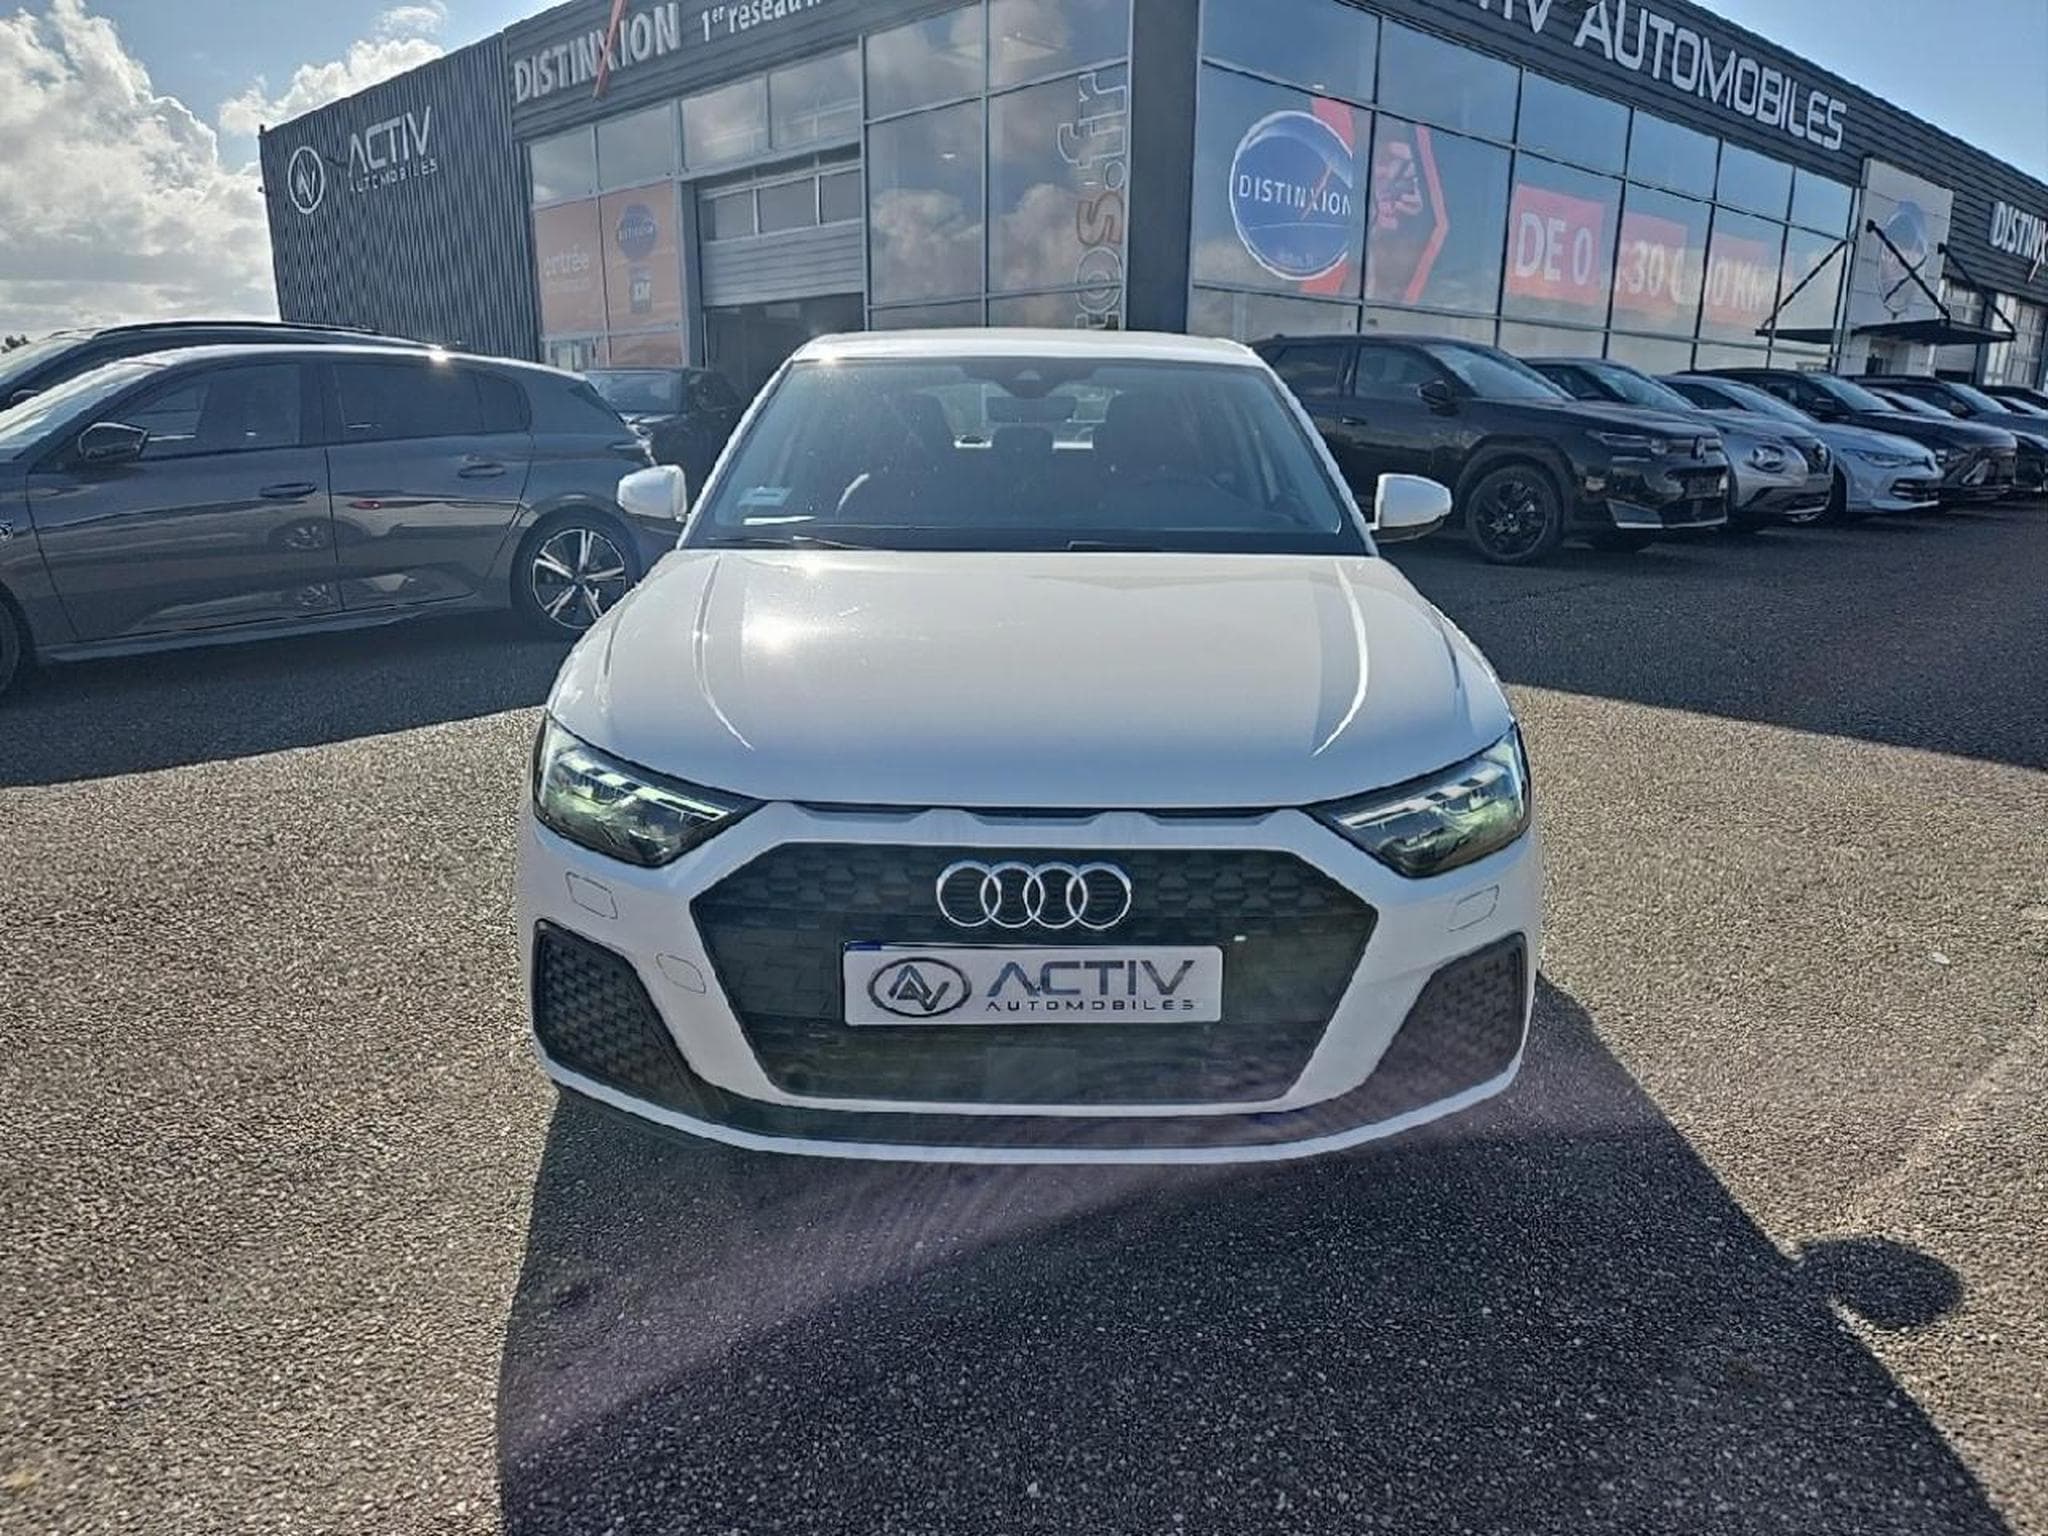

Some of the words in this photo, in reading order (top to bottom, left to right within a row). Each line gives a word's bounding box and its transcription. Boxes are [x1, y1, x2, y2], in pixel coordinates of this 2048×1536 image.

[514, 3, 680, 104] DISTINXION
[1573, 0, 1848, 151] AUTOMOBILES
[348, 106, 431, 178] ACTIV
[1515, 211, 1567, 282] DE
[985, 1000, 1195, 1012] AUTOMOBILES
[986, 960, 1195, 997] ACTIV
